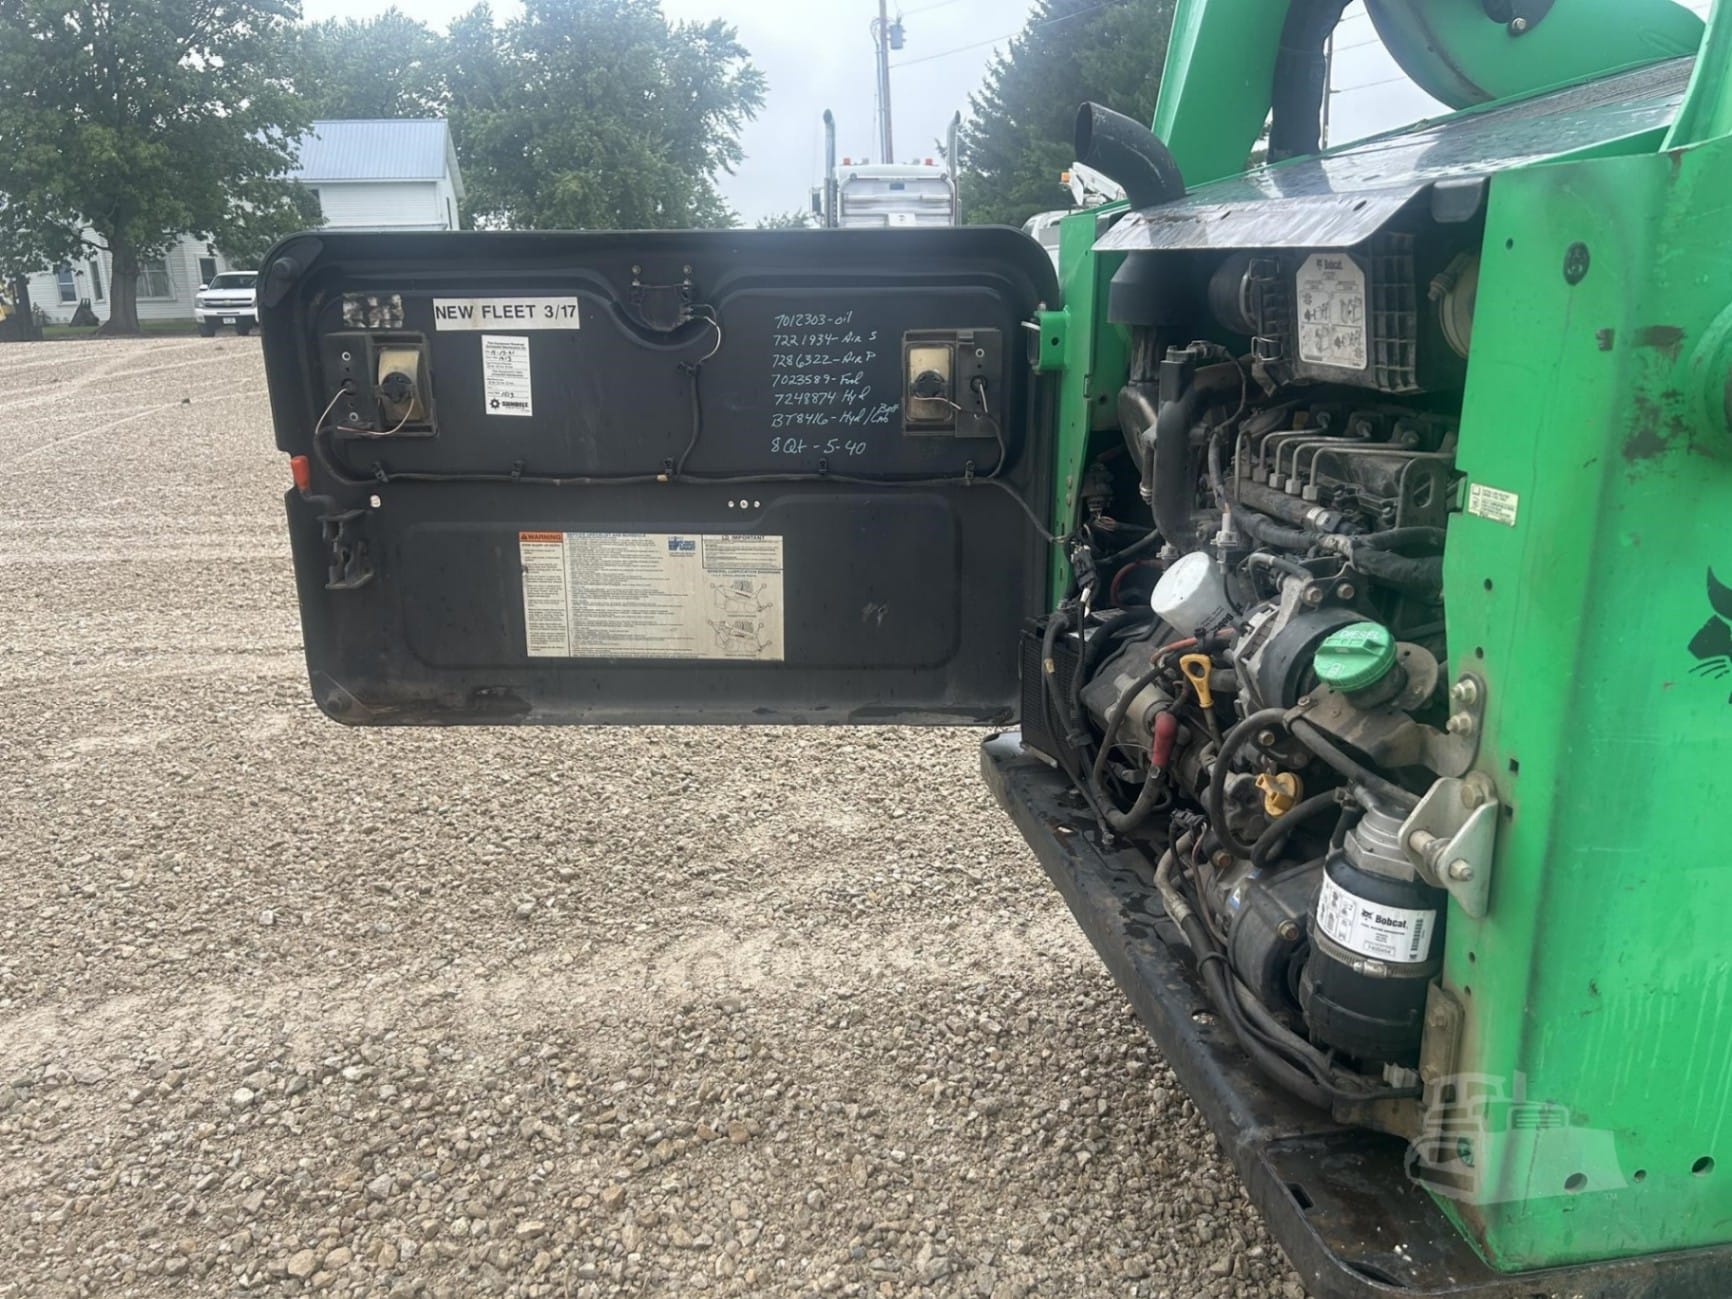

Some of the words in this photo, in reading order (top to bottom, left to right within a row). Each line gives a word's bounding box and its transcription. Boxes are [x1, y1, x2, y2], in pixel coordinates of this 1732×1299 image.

[436, 305, 473, 319] NEW
[482, 305, 536, 319] FLEET
[544, 304, 577, 320] 3/17
[1375, 914, 1407, 929] Bobcat
